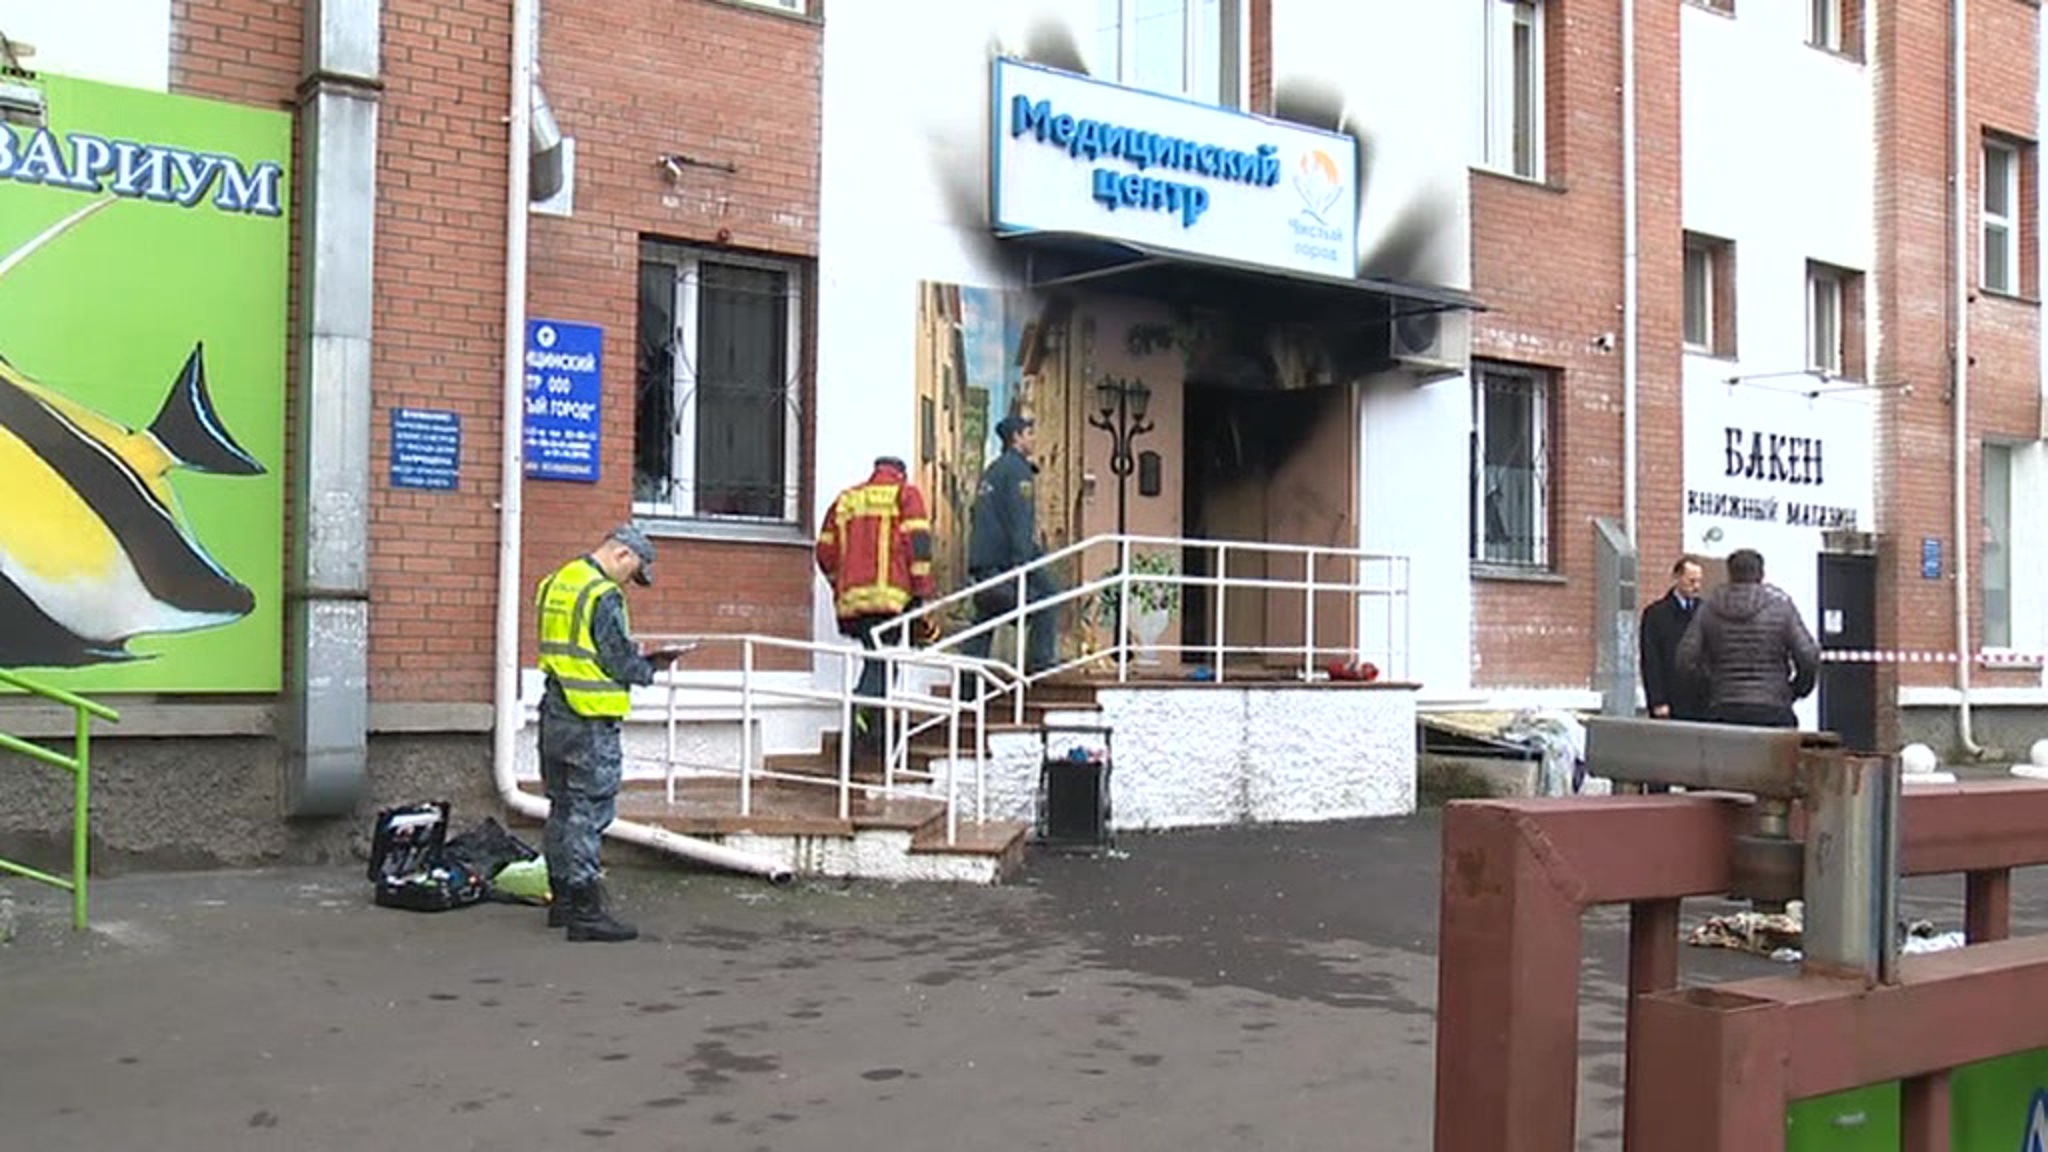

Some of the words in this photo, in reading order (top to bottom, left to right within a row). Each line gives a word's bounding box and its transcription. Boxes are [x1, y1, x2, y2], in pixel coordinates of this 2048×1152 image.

[1011, 94, 1281, 188] Медицинский
[1092, 167, 1210, 228] центр
[1724, 427, 1824, 486] БАКЕН
[1687, 489, 1779, 522] КНИЖНЫЙ
[1786, 501, 1857, 528] МАГАЗИН
